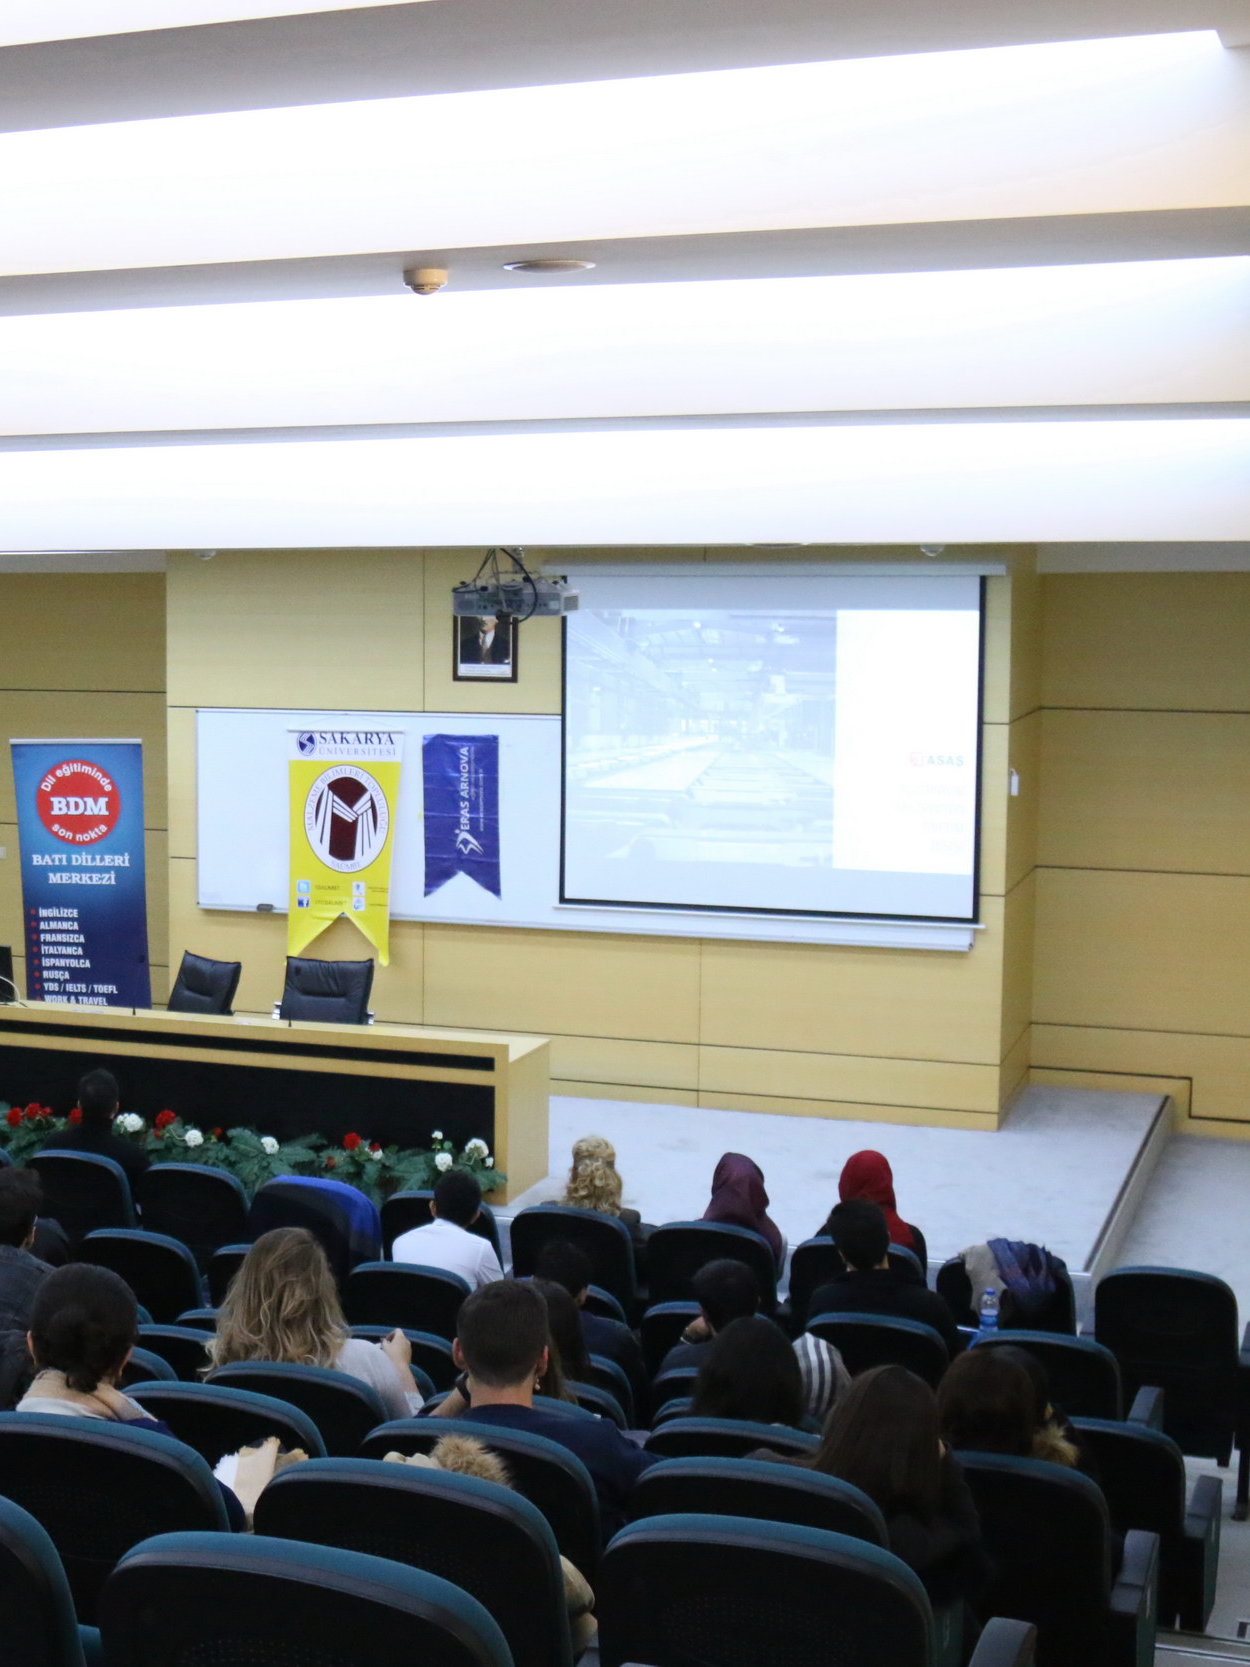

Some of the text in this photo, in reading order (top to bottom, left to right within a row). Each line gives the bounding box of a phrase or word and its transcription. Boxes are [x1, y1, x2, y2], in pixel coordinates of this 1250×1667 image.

[319, 731, 395, 745] SAKARYA
[319, 746, 396, 756] ÜNİVERSİTESİ
[41, 762, 113, 792] Dil eğitiminde
[459, 746, 470, 831] ERAS ARNOVA
[50, 797, 109, 816] BDM
[52, 823, 108, 842] son nokta
[32, 852, 130, 867] BATI DİLLERİ
[48, 871, 116, 885] MERKEZİ
[38, 907, 79, 918] İNGİLİZCE
[39, 921, 79, 931] ALMANCA
[40, 933, 85, 943] FRANSIZCA
[41, 944, 83, 955] İTALYANCA
[41, 957, 91, 968] İSPANYOLCA
[42, 970, 70, 981] RUSÇA
[43, 982, 59, 992] YDS
[65, 983, 87, 993] IELTS
[93, 984, 118, 994] TOEFL
[44, 994, 69, 1004] WORK
[78, 996, 109, 1006] TRAVEL
